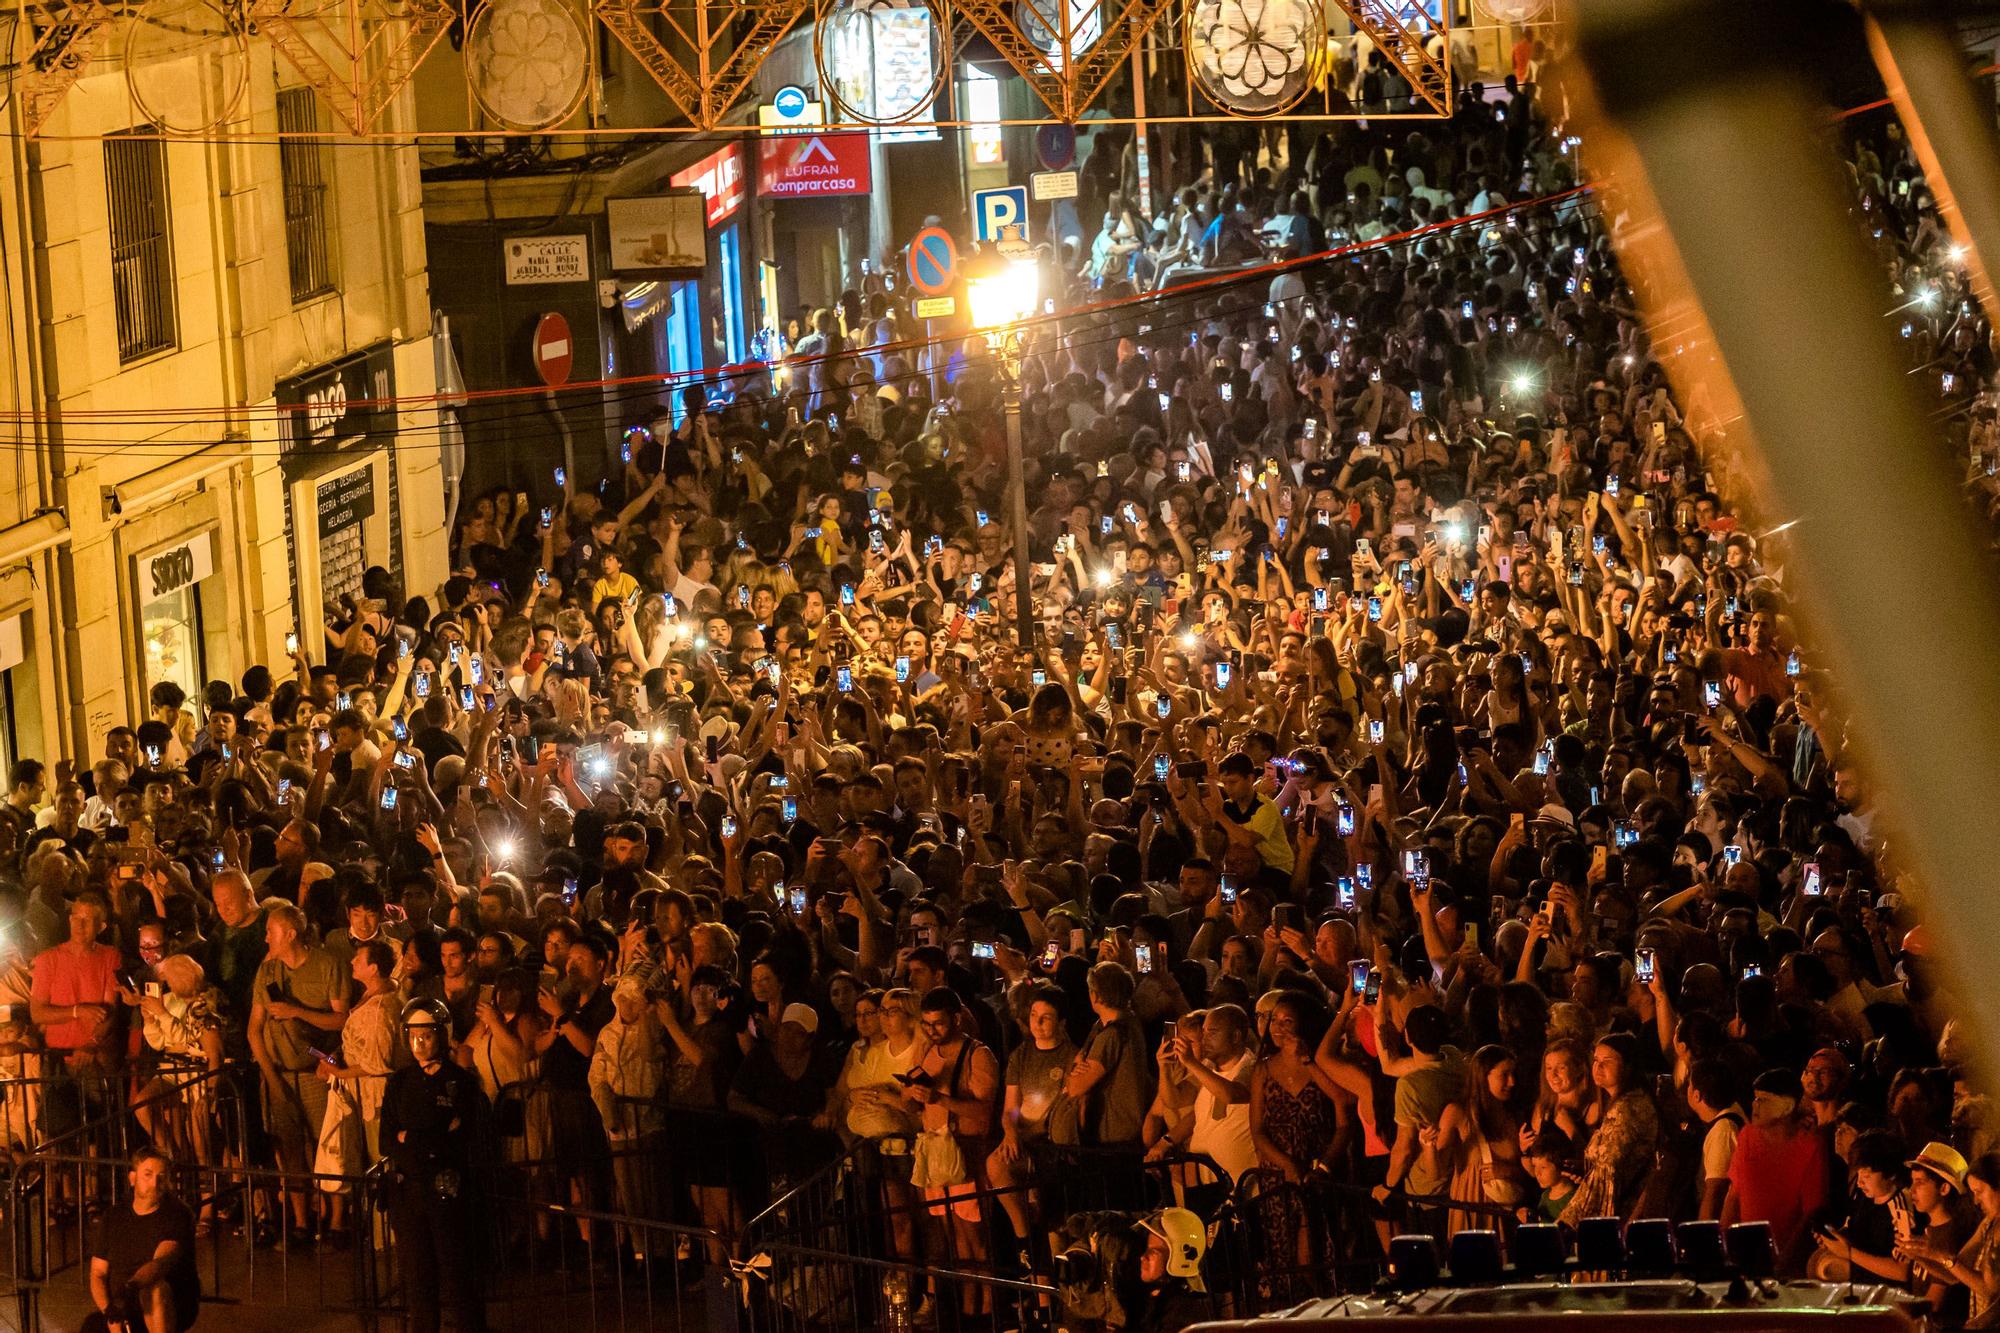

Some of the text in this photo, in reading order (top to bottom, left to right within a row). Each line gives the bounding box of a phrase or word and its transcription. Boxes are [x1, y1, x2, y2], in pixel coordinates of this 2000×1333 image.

[785, 165, 839, 177] LUFRAN
[771, 178, 856, 194] comprarcasa
[985, 194, 1017, 242] P
[540, 246, 570, 256] CALLE
[340, 467, 367, 488] DESAYUNOS
[340, 482, 371, 504] RESTAURANTE
[327, 505, 354, 529] HELADERÍA
